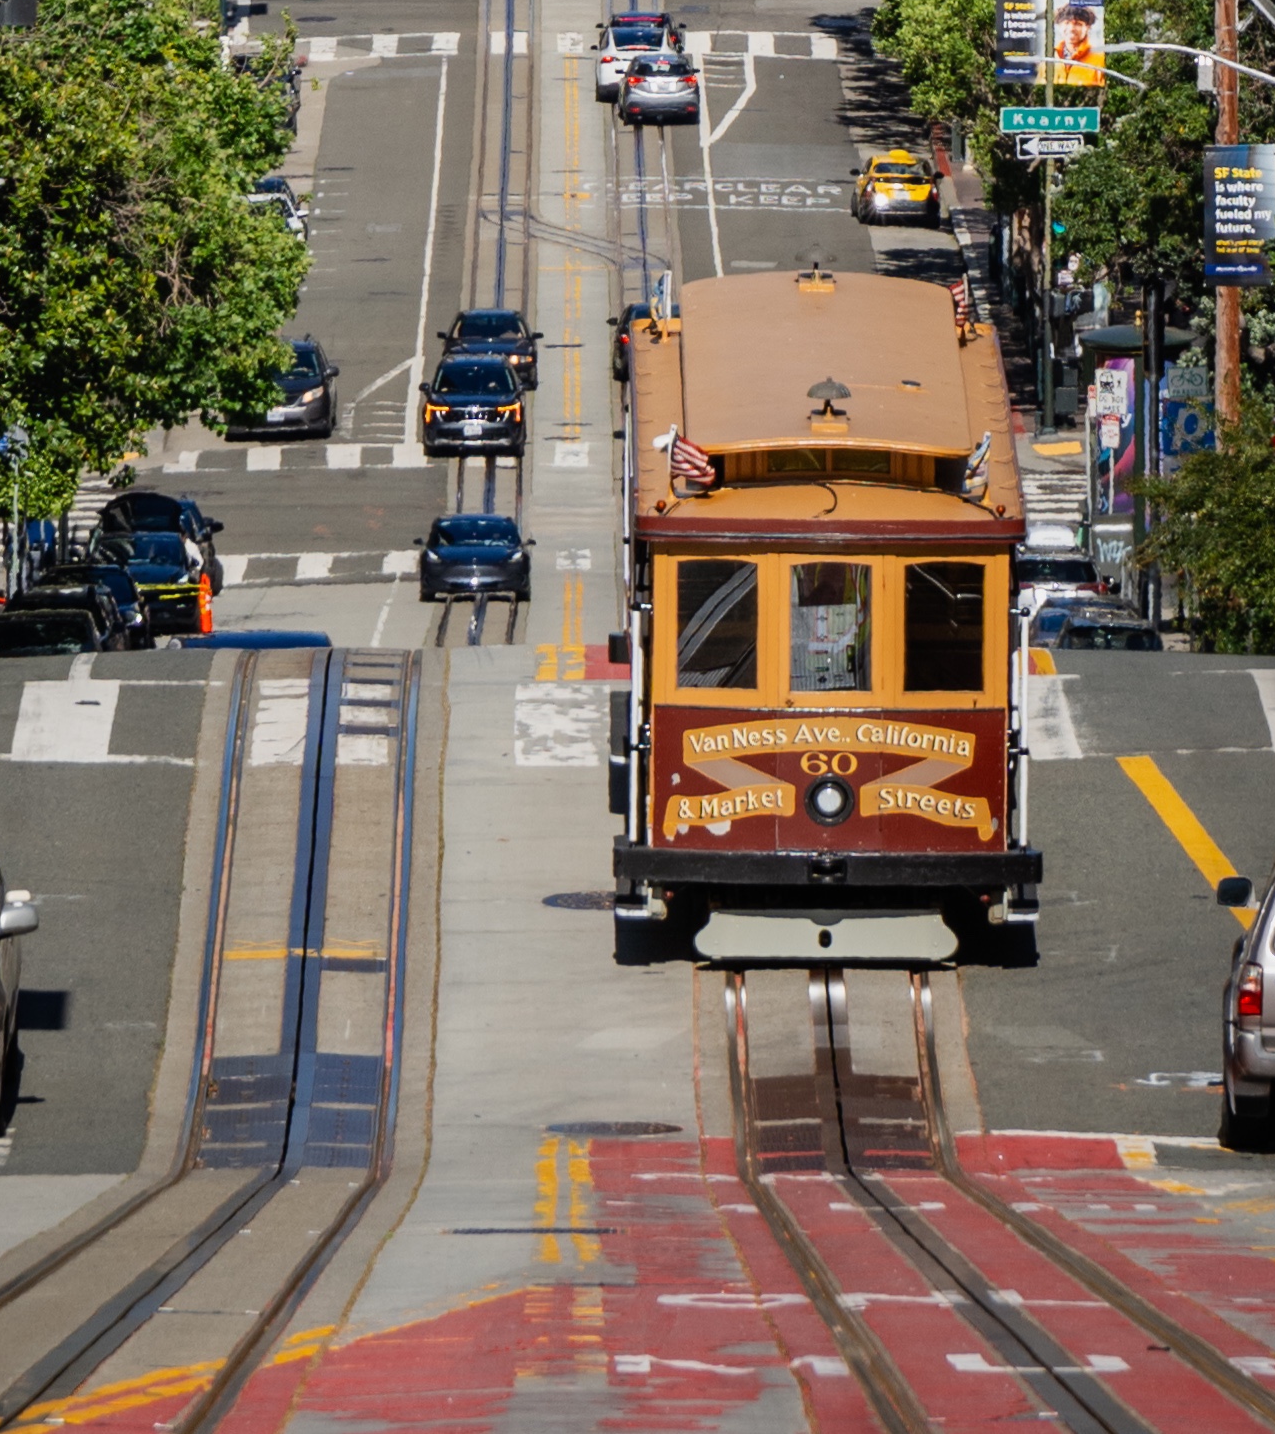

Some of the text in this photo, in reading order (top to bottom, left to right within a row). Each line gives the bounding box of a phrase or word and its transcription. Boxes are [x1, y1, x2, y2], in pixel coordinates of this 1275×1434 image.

[1013, 113, 1087, 129] Kearny
[1038, 141, 1076, 152] ONE WAY
[1214, 167, 1263, 179] SF State
[1215, 181, 1264, 193] is where
[1215, 195, 1256, 207] faculty
[1215, 209, 1272, 223] fueled my
[1215, 223, 1255, 234] future.
[689, 731, 728, 754] Van
[732, 727, 788, 749] Ness
[856, 723, 970, 758] California
[800, 751, 858, 776] 60
[678, 787, 977, 819] & Market Streets
